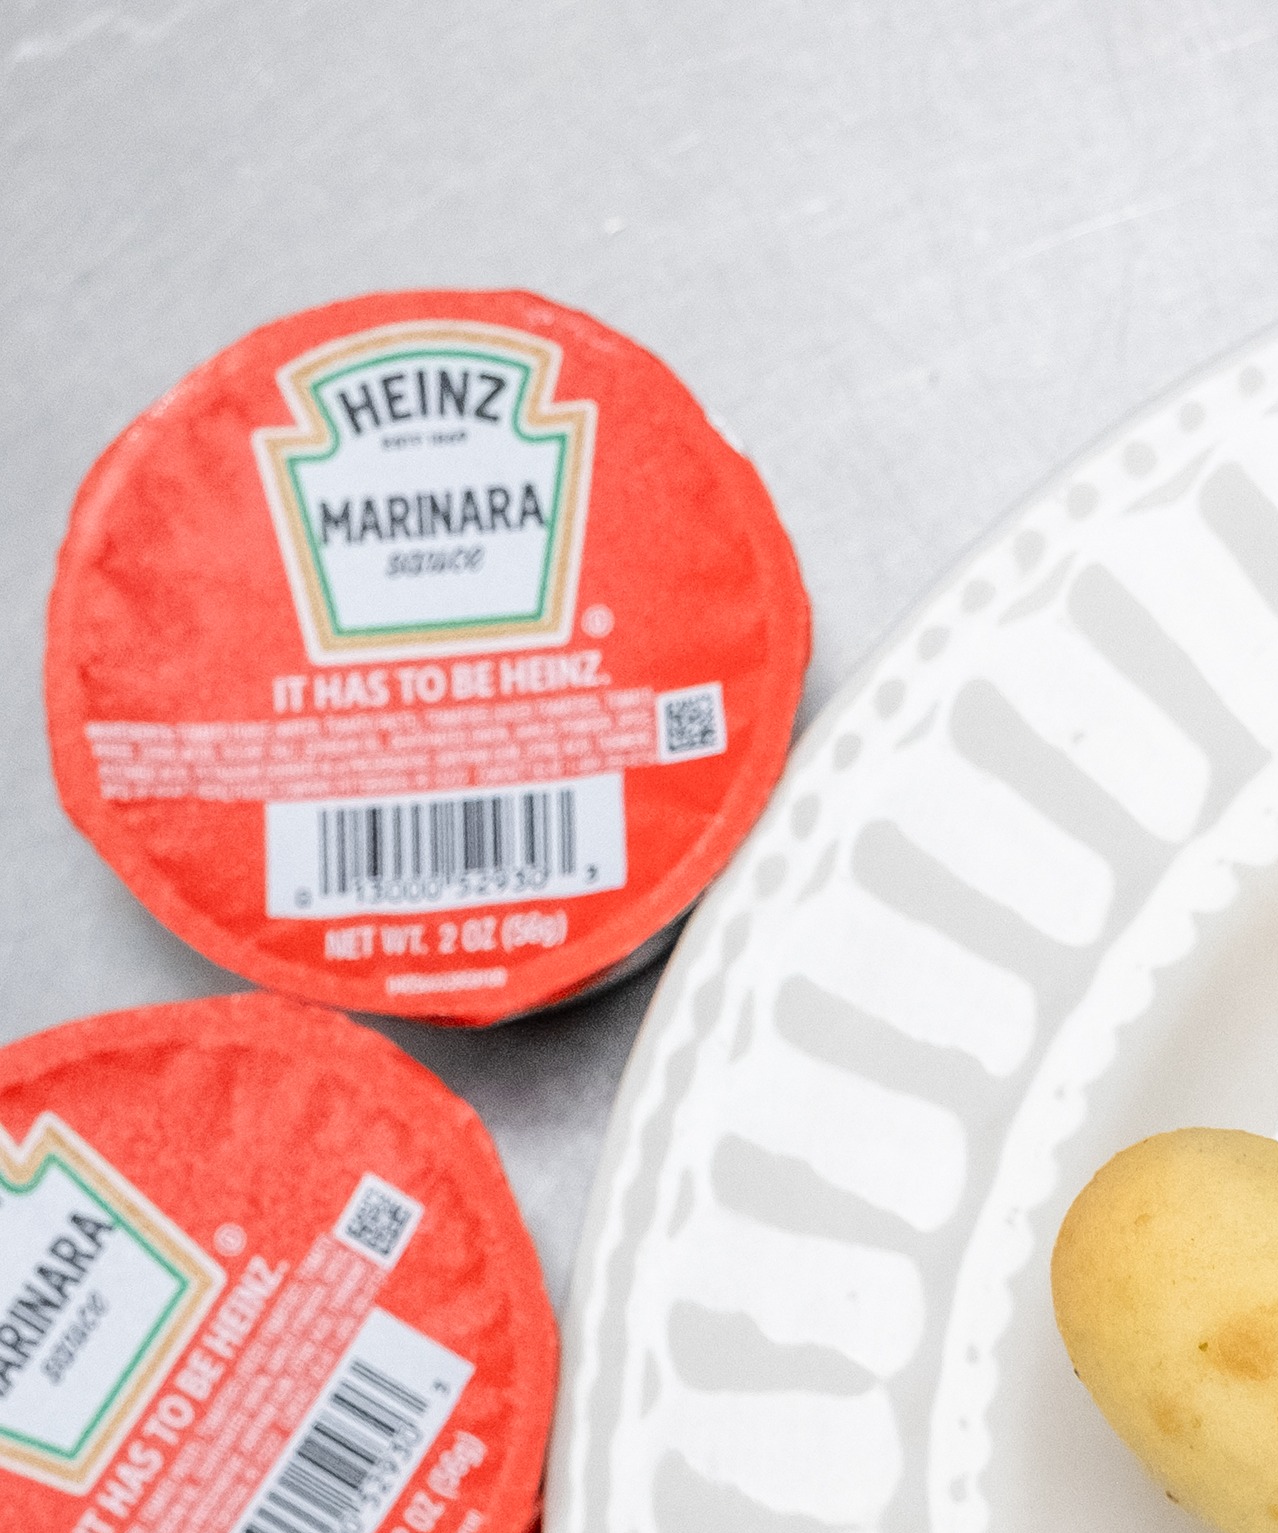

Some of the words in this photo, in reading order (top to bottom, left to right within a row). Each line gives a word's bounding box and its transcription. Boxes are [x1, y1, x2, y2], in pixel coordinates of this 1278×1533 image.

[338, 367, 507, 434] HEINZ
[319, 481, 547, 546] MARINARA
[272, 674, 307, 714] IT
[313, 668, 390, 710] HAS
[394, 664, 447, 704] TO
[450, 660, 494, 699] BE
[500, 650, 612, 694] HEINZ.
[324, 924, 374, 960] NET
[380, 923, 428, 956] WT.
[437, 922, 459, 955] 2
[460, 914, 496, 953] OZ
[0, 1211, 117, 1396] ARINARA
[97, 1441, 164, 1519] HAS
[141, 1394, 195, 1446] TO
[173, 1350, 226, 1401] BE
[202, 1254, 291, 1360] HEINZ.
[402, 1490, 446, 1533] OZ
